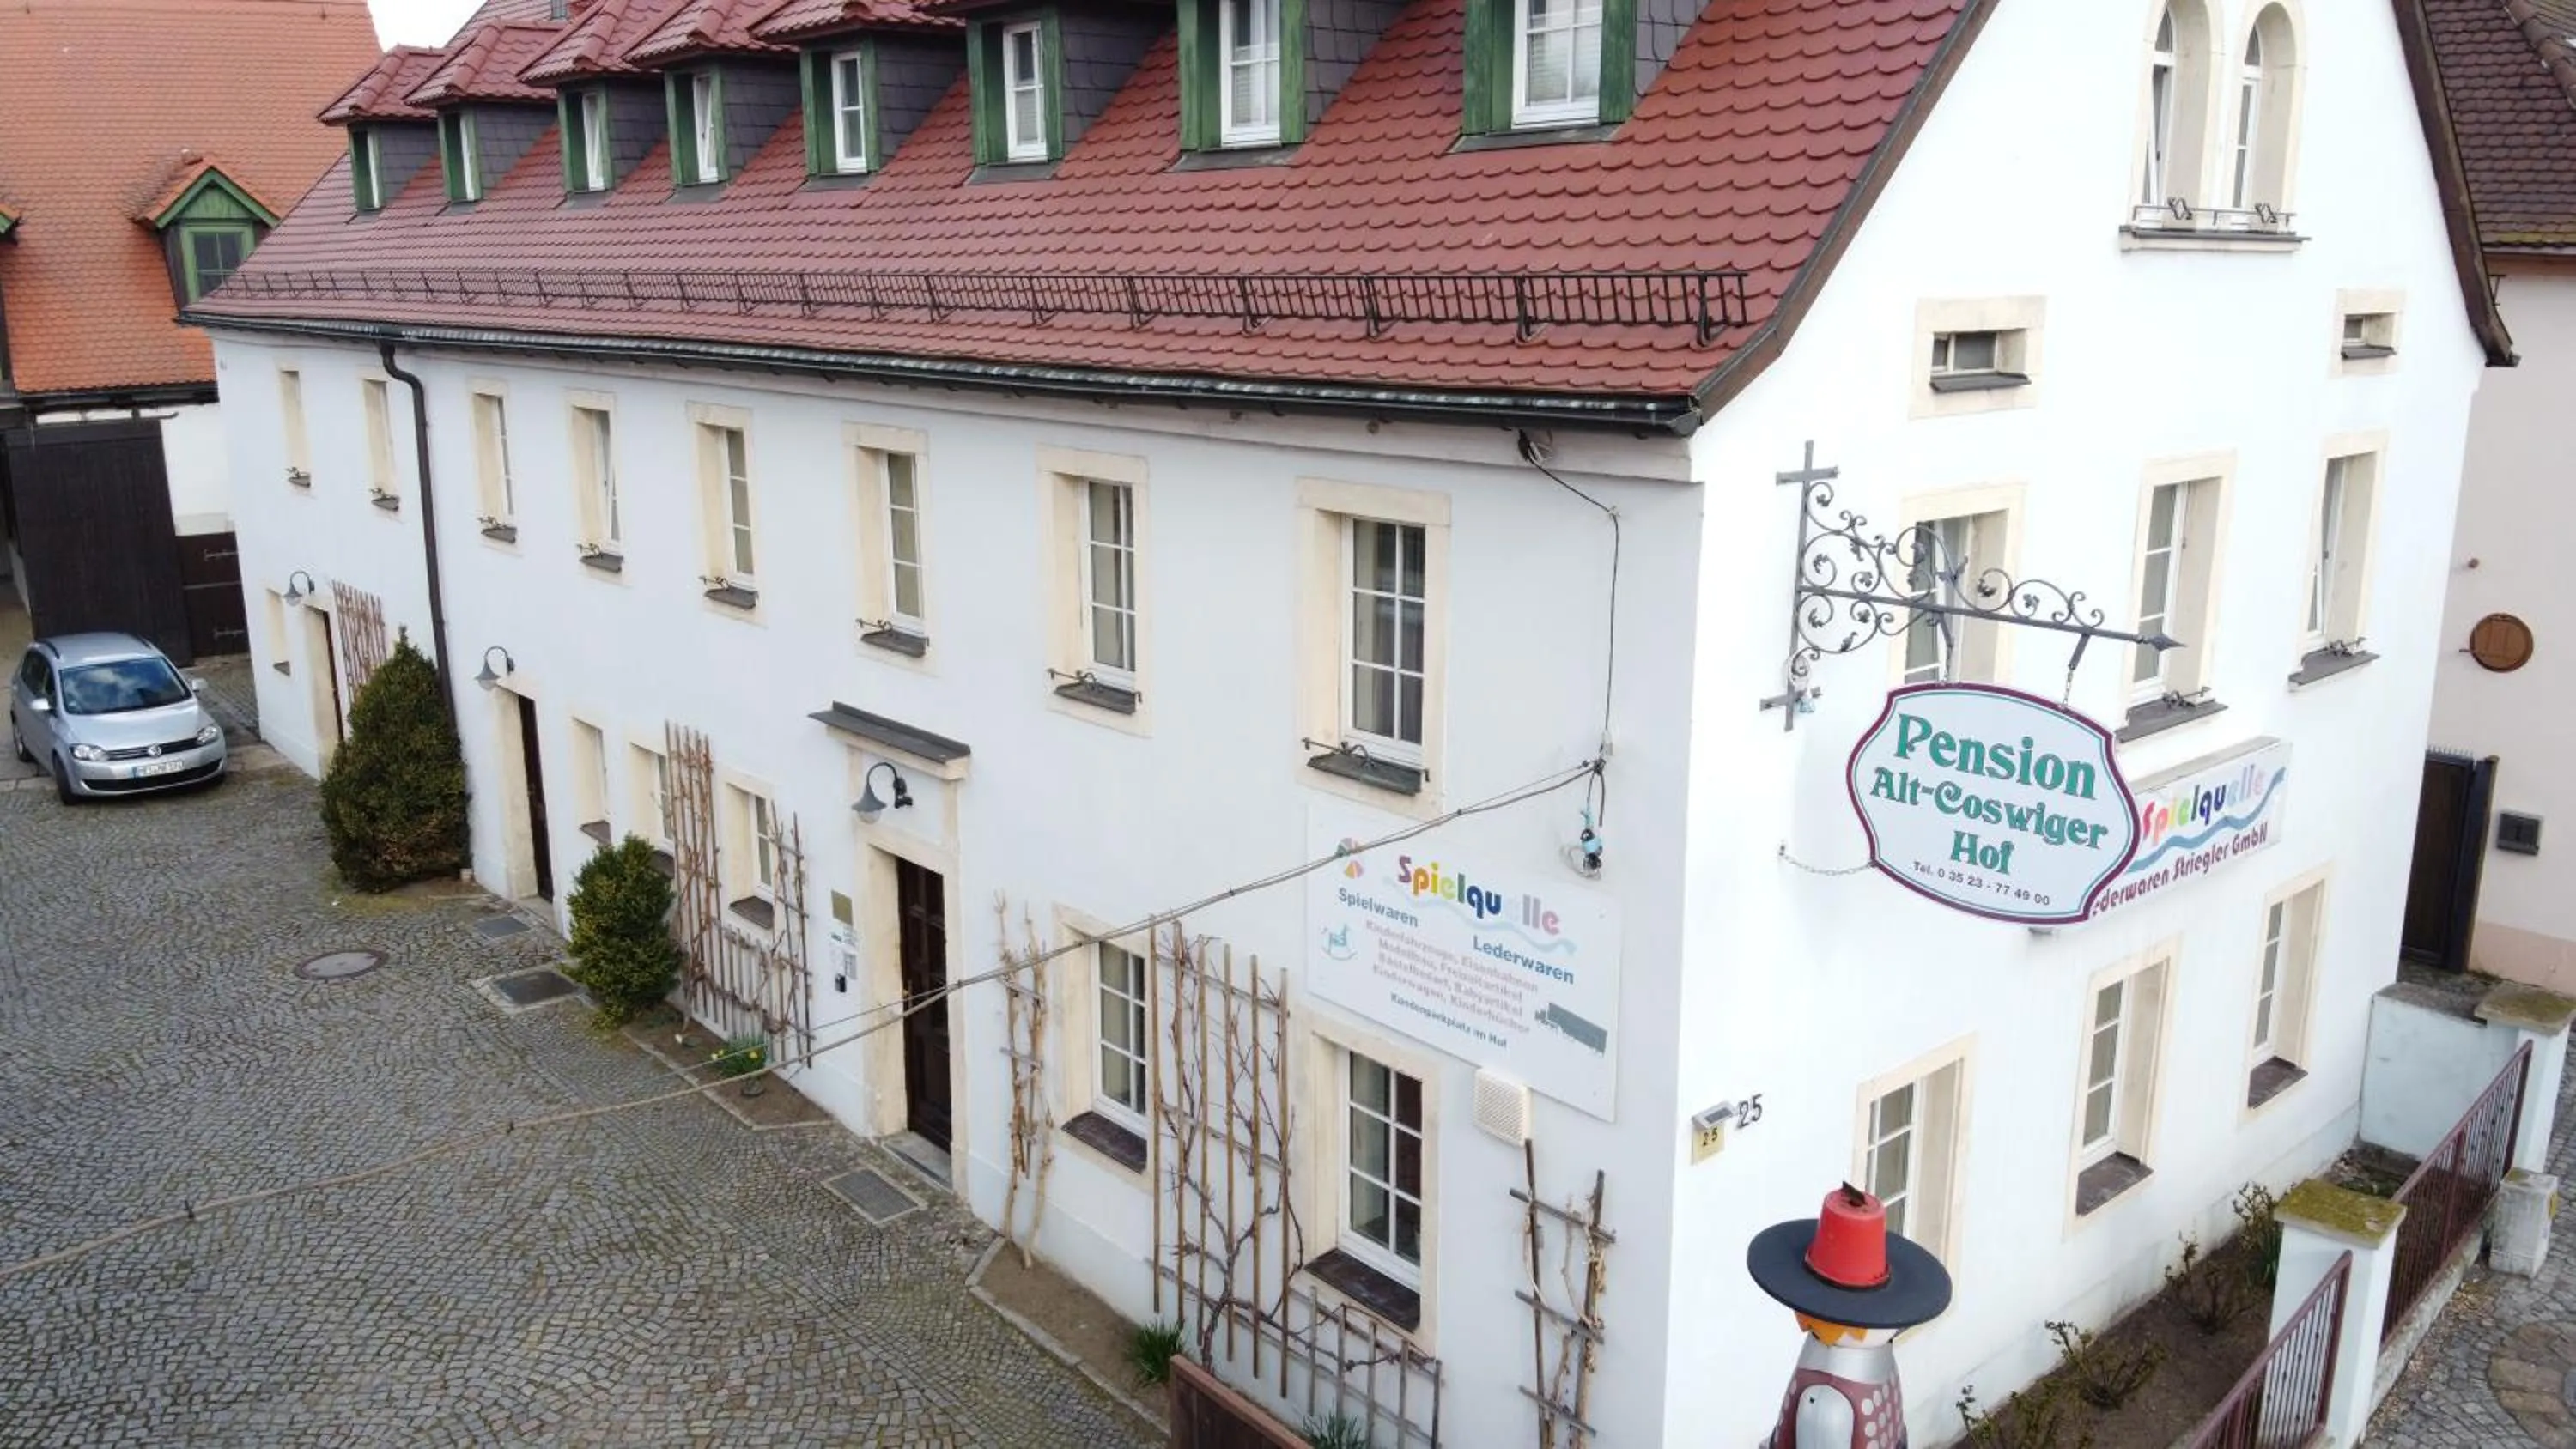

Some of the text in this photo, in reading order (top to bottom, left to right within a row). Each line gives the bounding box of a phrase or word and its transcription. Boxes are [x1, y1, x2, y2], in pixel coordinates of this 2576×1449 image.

[1894, 712, 2097, 801] Pension
[1869, 766, 2110, 850] Alt-Coswiger
[2142, 762, 2266, 844] Spielquelle
[1913, 861, 1932, 876] Tel.
[1937, 868, 1945, 878] 0
[1948, 870, 1964, 883] 35
[1967, 876, 1983, 888] 23
[1996, 882, 2010, 894] 77
[2014, 888, 2030, 900] 49
[2033, 894, 2050, 906] 00
[1950, 830, 2015, 876] Hof
[2093, 822, 2268, 916] derwaren Striegler GmbH
[1338, 886, 1419, 929] Spielwaren
[1397, 855, 1561, 937] Spielqulle
[1472, 935, 1575, 985] Lederwaren
[1736, 1093, 1763, 1130] 25
